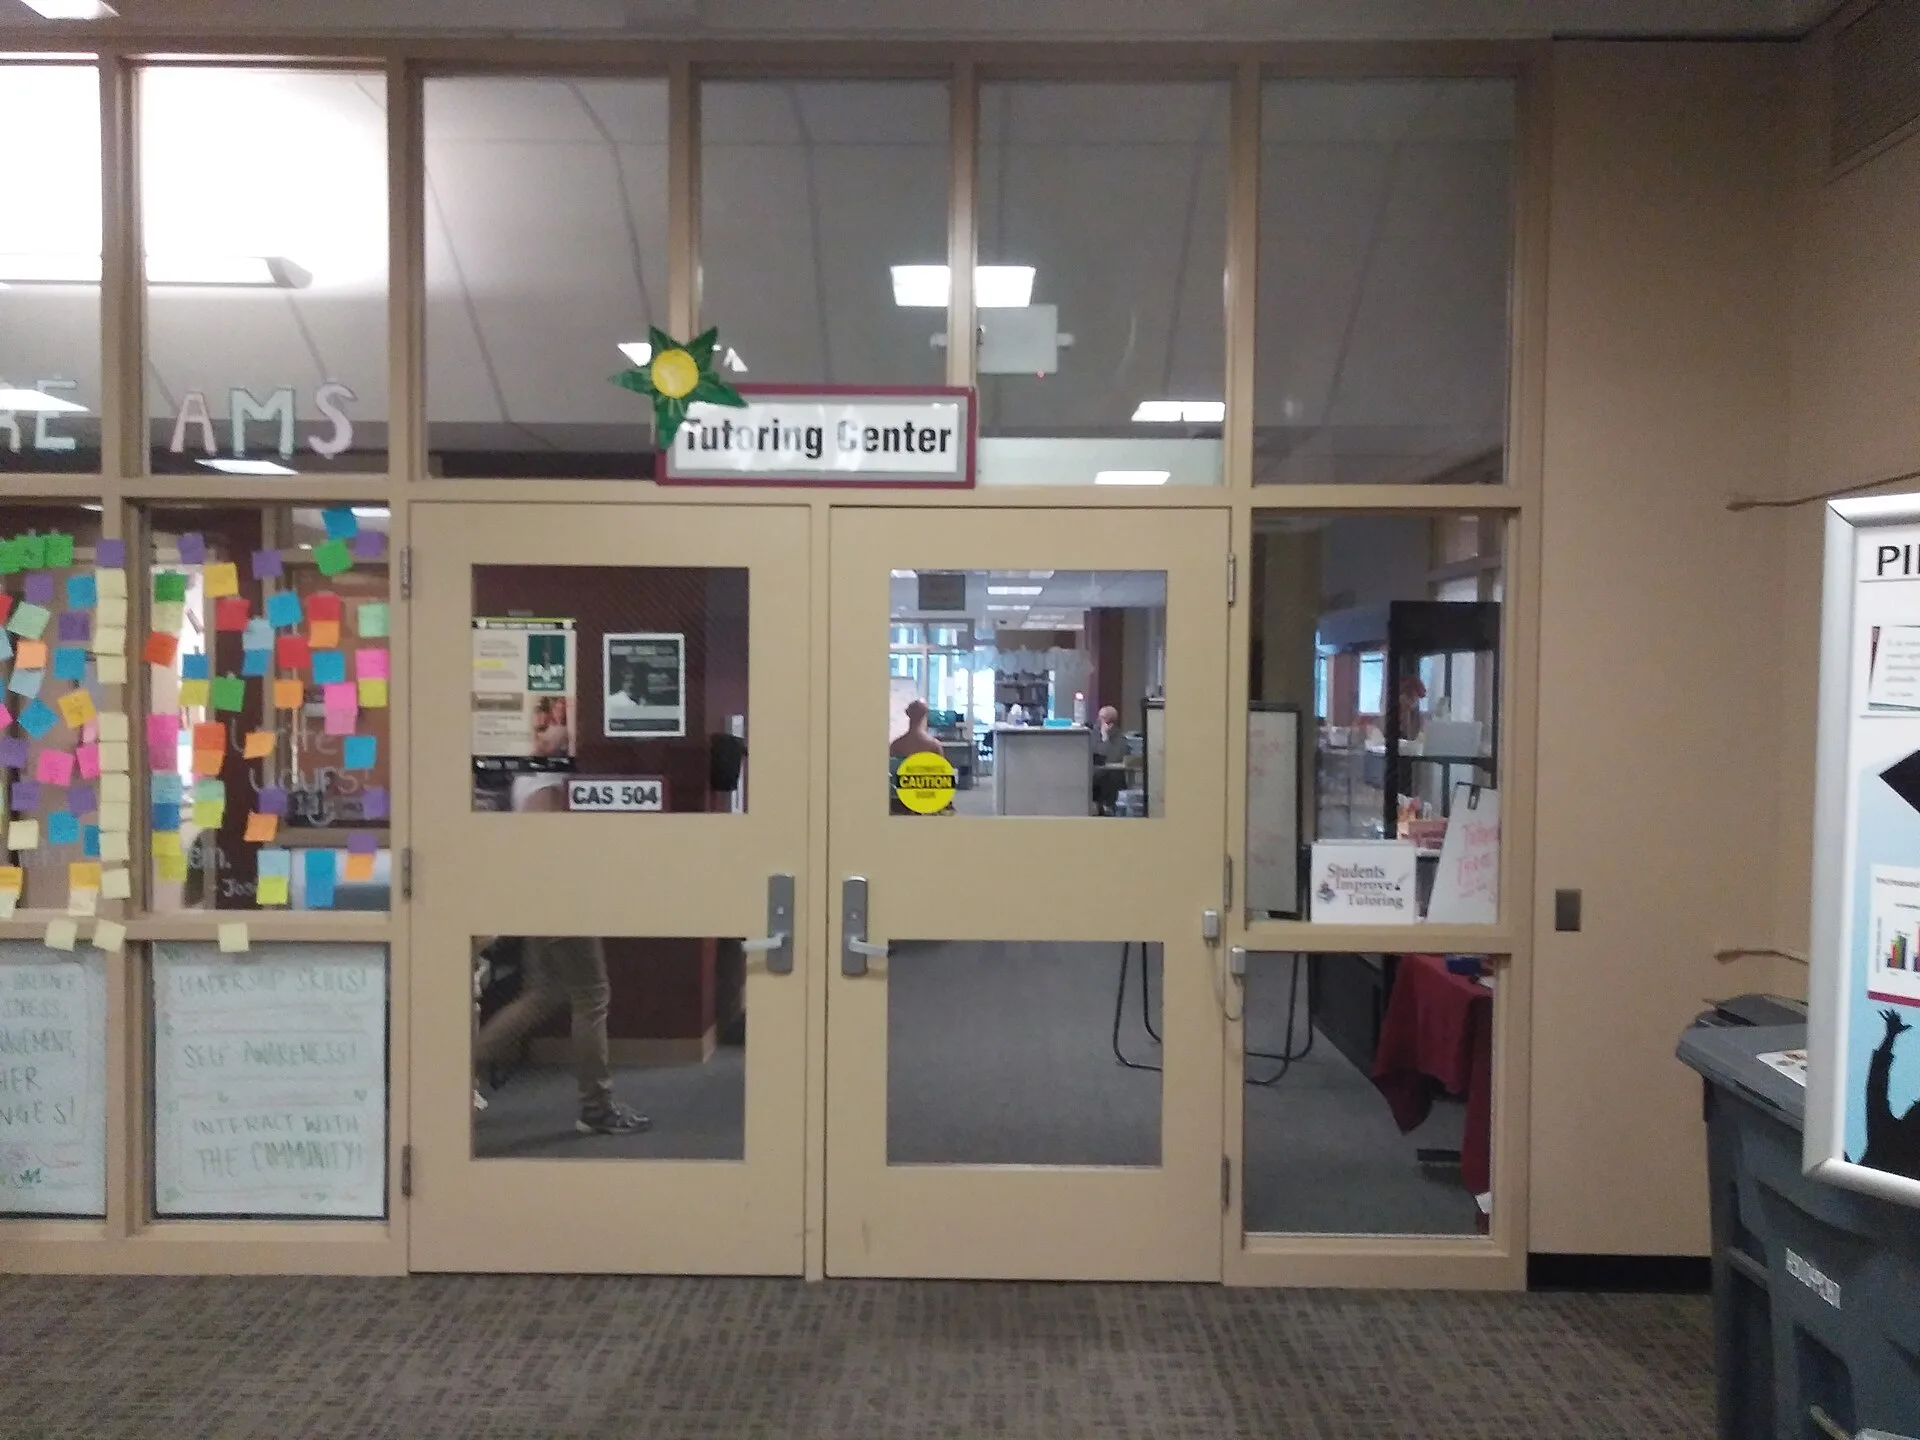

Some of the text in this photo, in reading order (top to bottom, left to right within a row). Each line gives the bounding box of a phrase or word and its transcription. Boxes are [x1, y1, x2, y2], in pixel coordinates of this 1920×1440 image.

[170, 382, 358, 458] AMS
[686, 418, 952, 459] Tutoring Center
[1877, 544, 1920, 576] PI
[899, 775, 952, 789] CAUTION
[572, 786, 659, 806] CAS 504
[1327, 862, 1386, 879] Students
[1335, 877, 1393, 893] Improve
[1348, 893, 1404, 910] Tutoring
